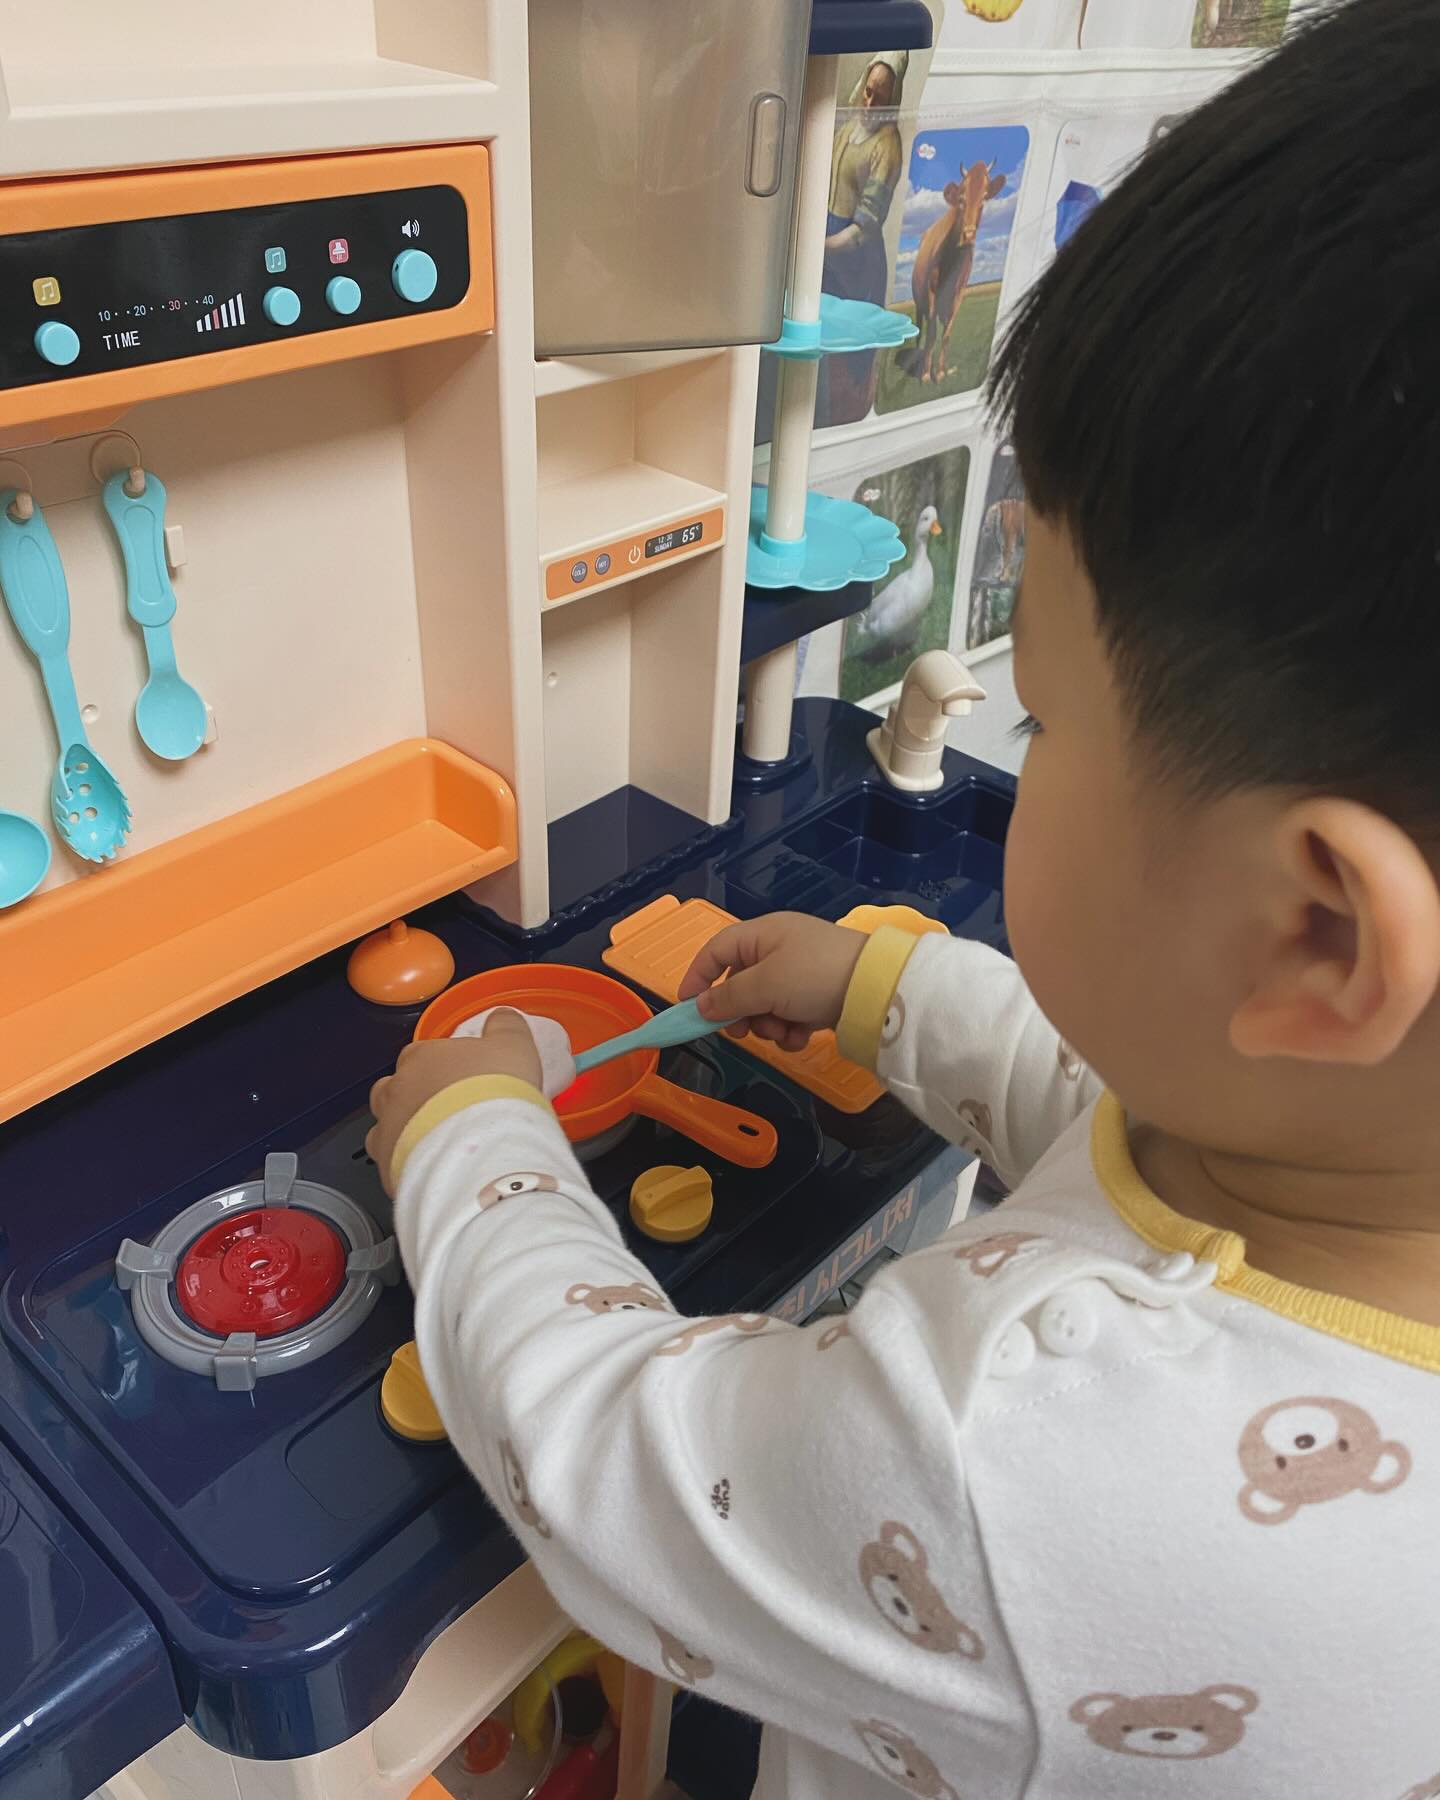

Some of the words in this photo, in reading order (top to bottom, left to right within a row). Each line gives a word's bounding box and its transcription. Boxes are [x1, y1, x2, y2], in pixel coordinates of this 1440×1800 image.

[98, 310, 111, 322] 10
[133, 305, 147, 317] 20
[168, 299, 181, 311] 30
[202, 294, 214, 306] 40
[102, 330, 141, 351] TIME
